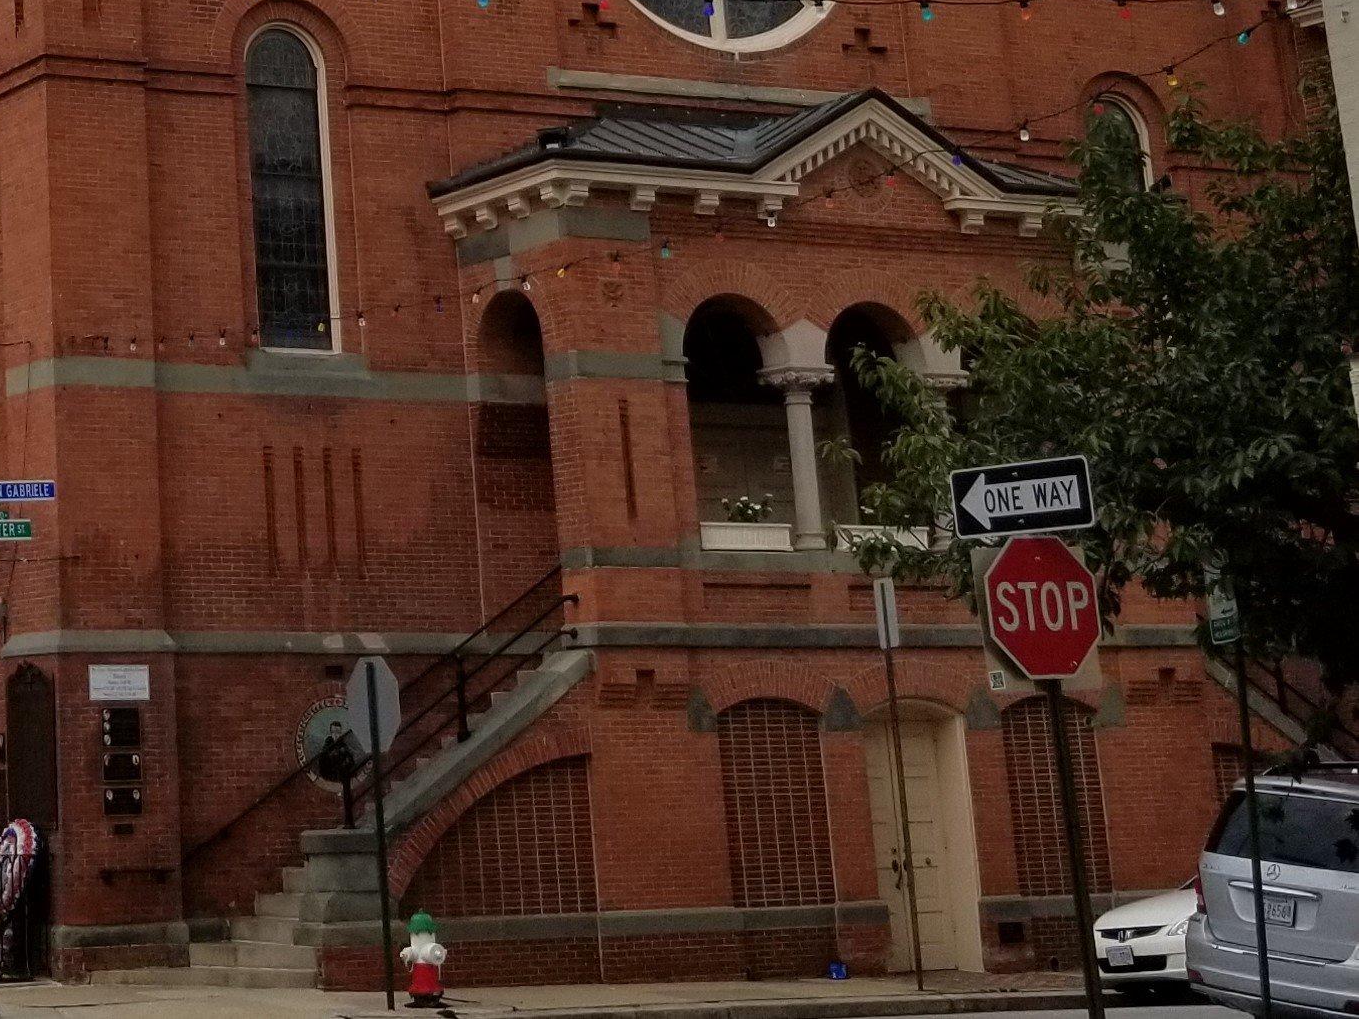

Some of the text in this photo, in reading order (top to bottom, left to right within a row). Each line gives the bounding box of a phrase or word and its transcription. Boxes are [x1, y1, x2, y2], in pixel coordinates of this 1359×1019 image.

[6, 483, 50, 497] GABRIELE
[984, 479, 1074, 513] ONE WAY
[996, 581, 1089, 632] STOP
